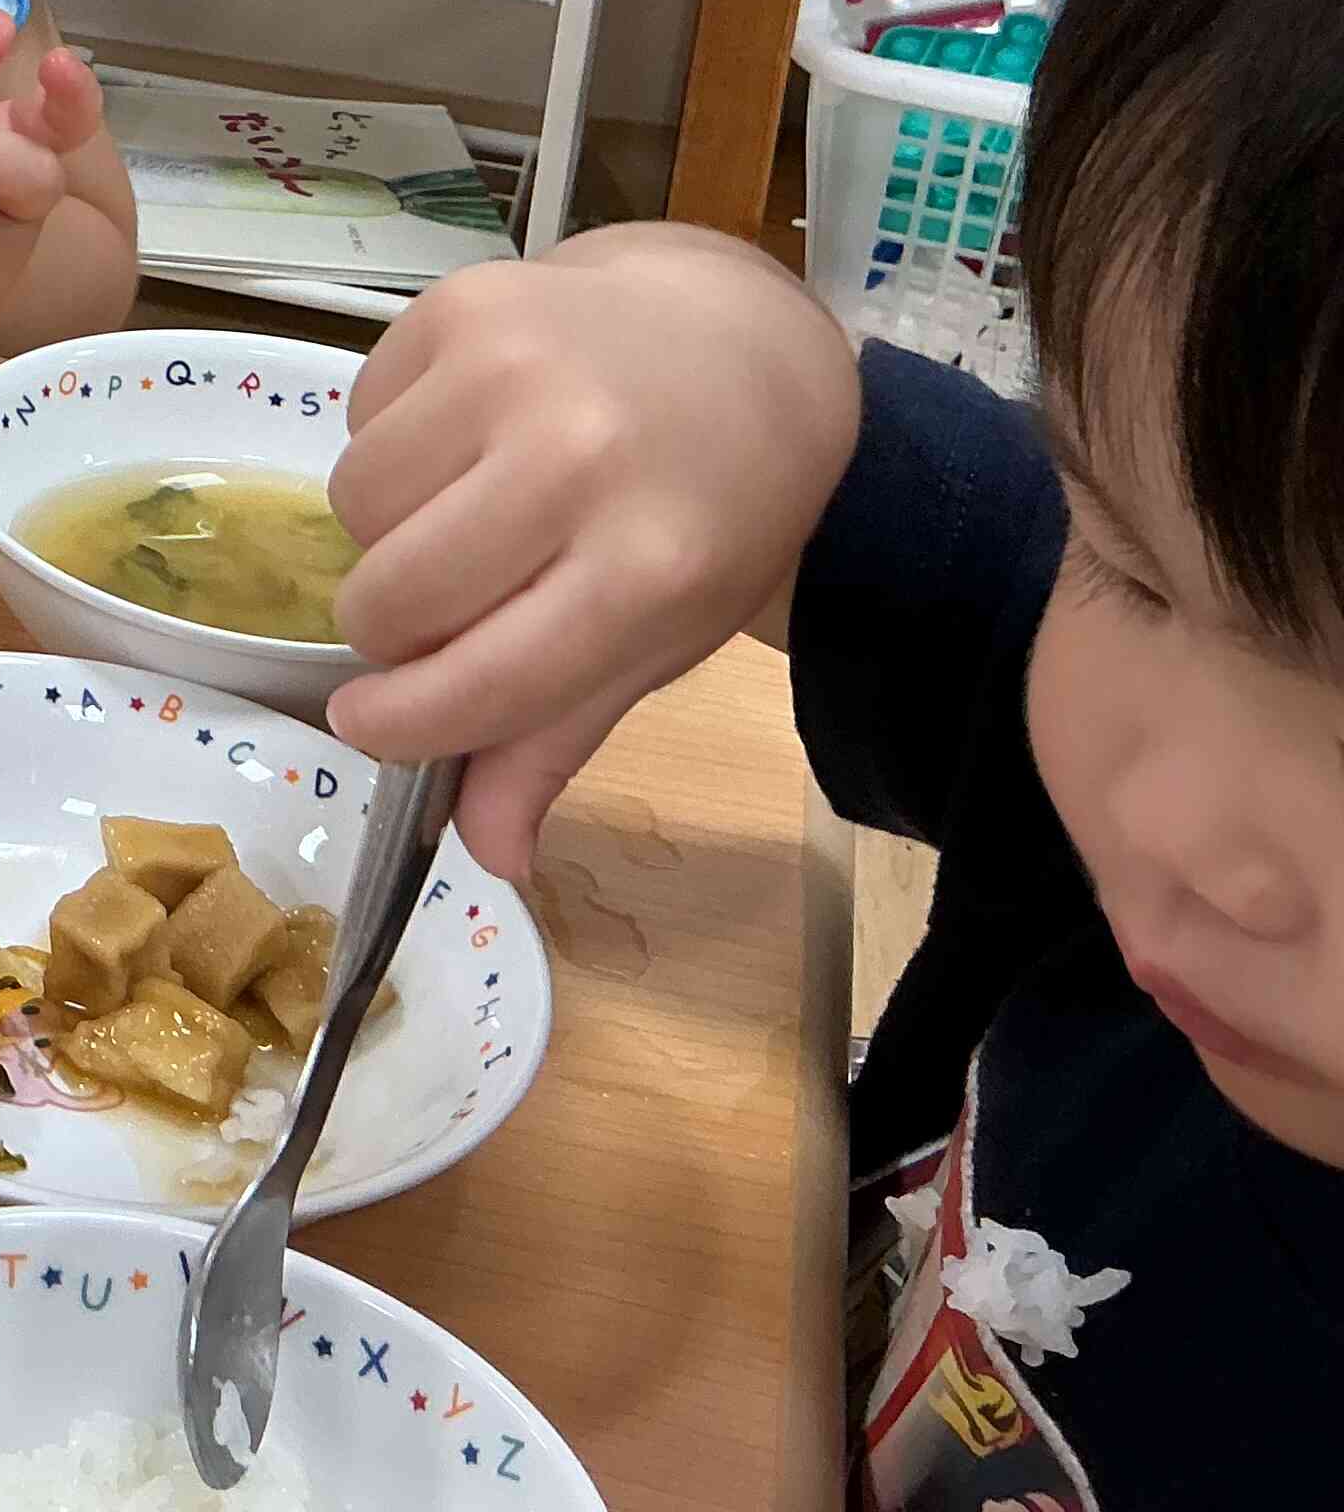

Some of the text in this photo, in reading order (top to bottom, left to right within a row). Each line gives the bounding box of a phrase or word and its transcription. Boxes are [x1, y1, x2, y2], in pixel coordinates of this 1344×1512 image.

[16, 395, 35, 426] N
[59, 371, 76, 396] O
[108, 376, 122, 400] P
[166, 360, 196, 386] Q
[238, 372, 260, 398] R
[301, 392, 320, 416] S
[81, 688, 102, 716] A
[159, 694, 183, 722] B
[228, 742, 255, 765] C
[315, 768, 338, 798] D
[423, 880, 451, 907] F
[471, 926, 498, 948] G
[0, 1254, 27, 1288] T
[81, 1273, 112, 1311] U
[358, 1338, 389, 1383] X
[443, 1383, 473, 1419] Y
[497, 1435, 524, 1481] Z
